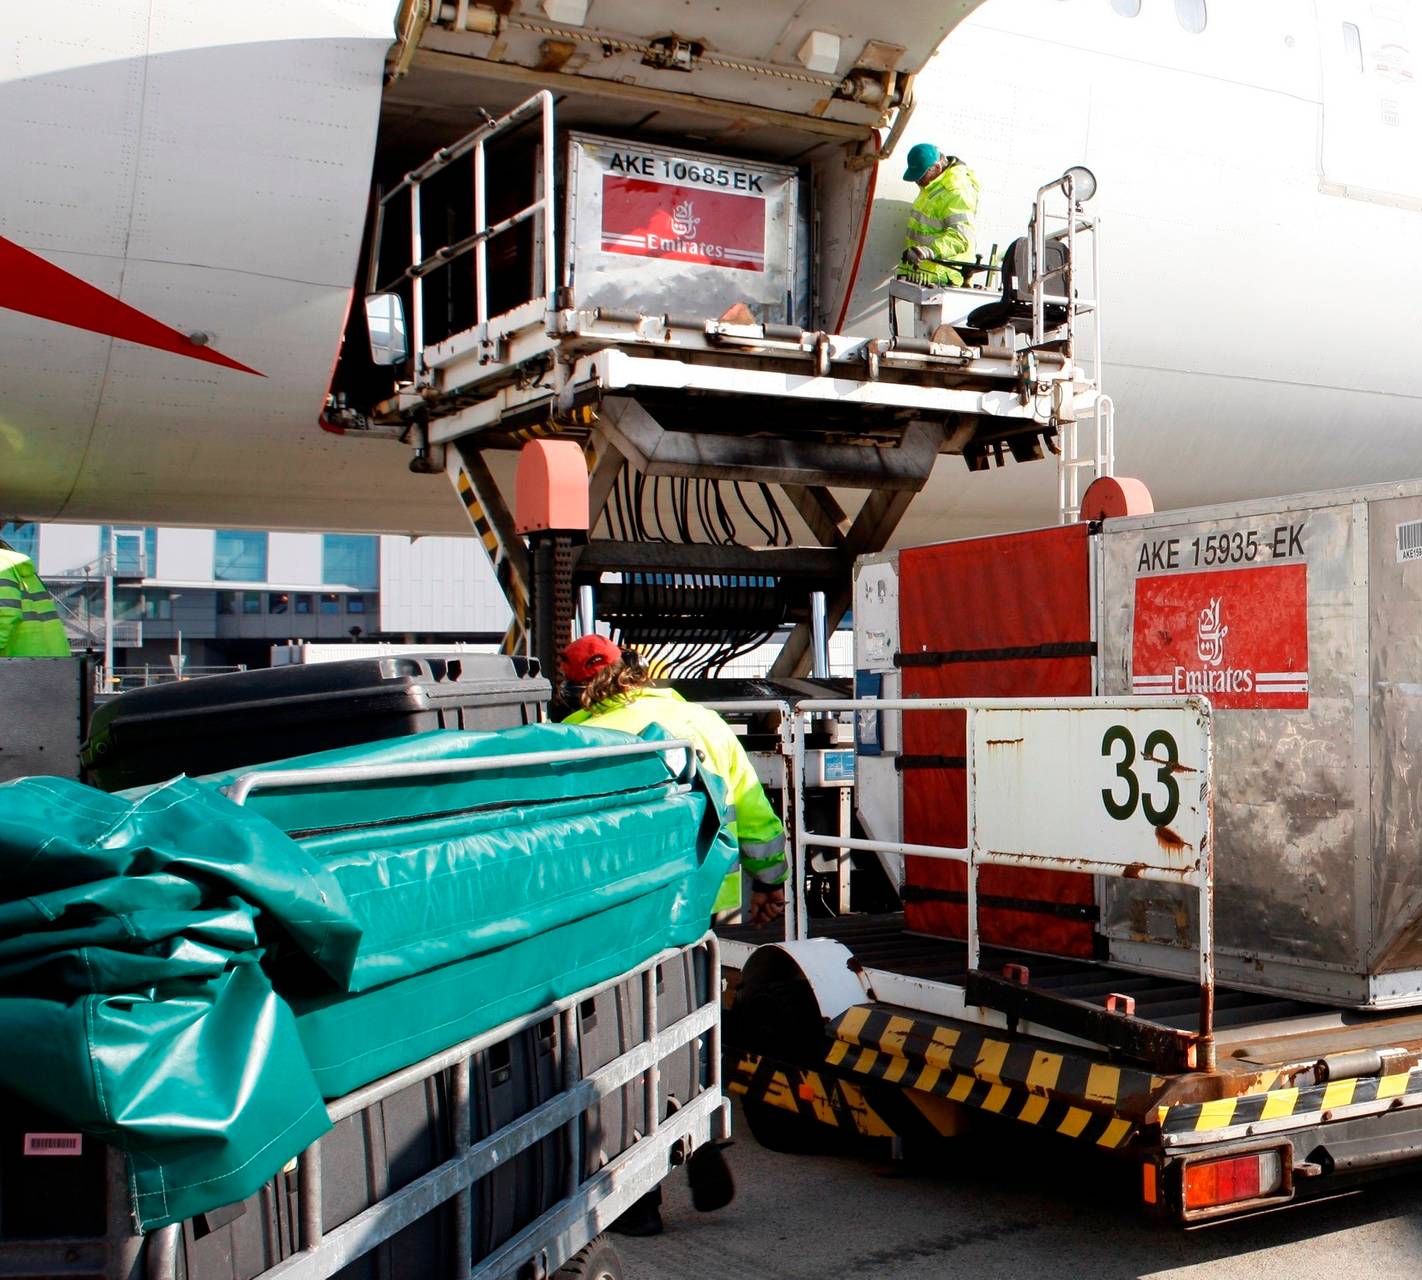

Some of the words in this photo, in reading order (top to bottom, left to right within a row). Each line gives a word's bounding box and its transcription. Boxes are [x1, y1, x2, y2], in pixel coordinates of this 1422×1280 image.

[610, 152, 655, 176] AKE
[663, 161, 729, 186] 10685
[734, 172, 764, 193] EK
[647, 233, 725, 258] Emirates
[1137, 539, 1180, 573] AKE
[1192, 530, 1258, 566] 15935
[1272, 523, 1306, 559] EK
[1174, 664, 1253, 694] Emirates
[1101, 724, 1181, 828] 33
